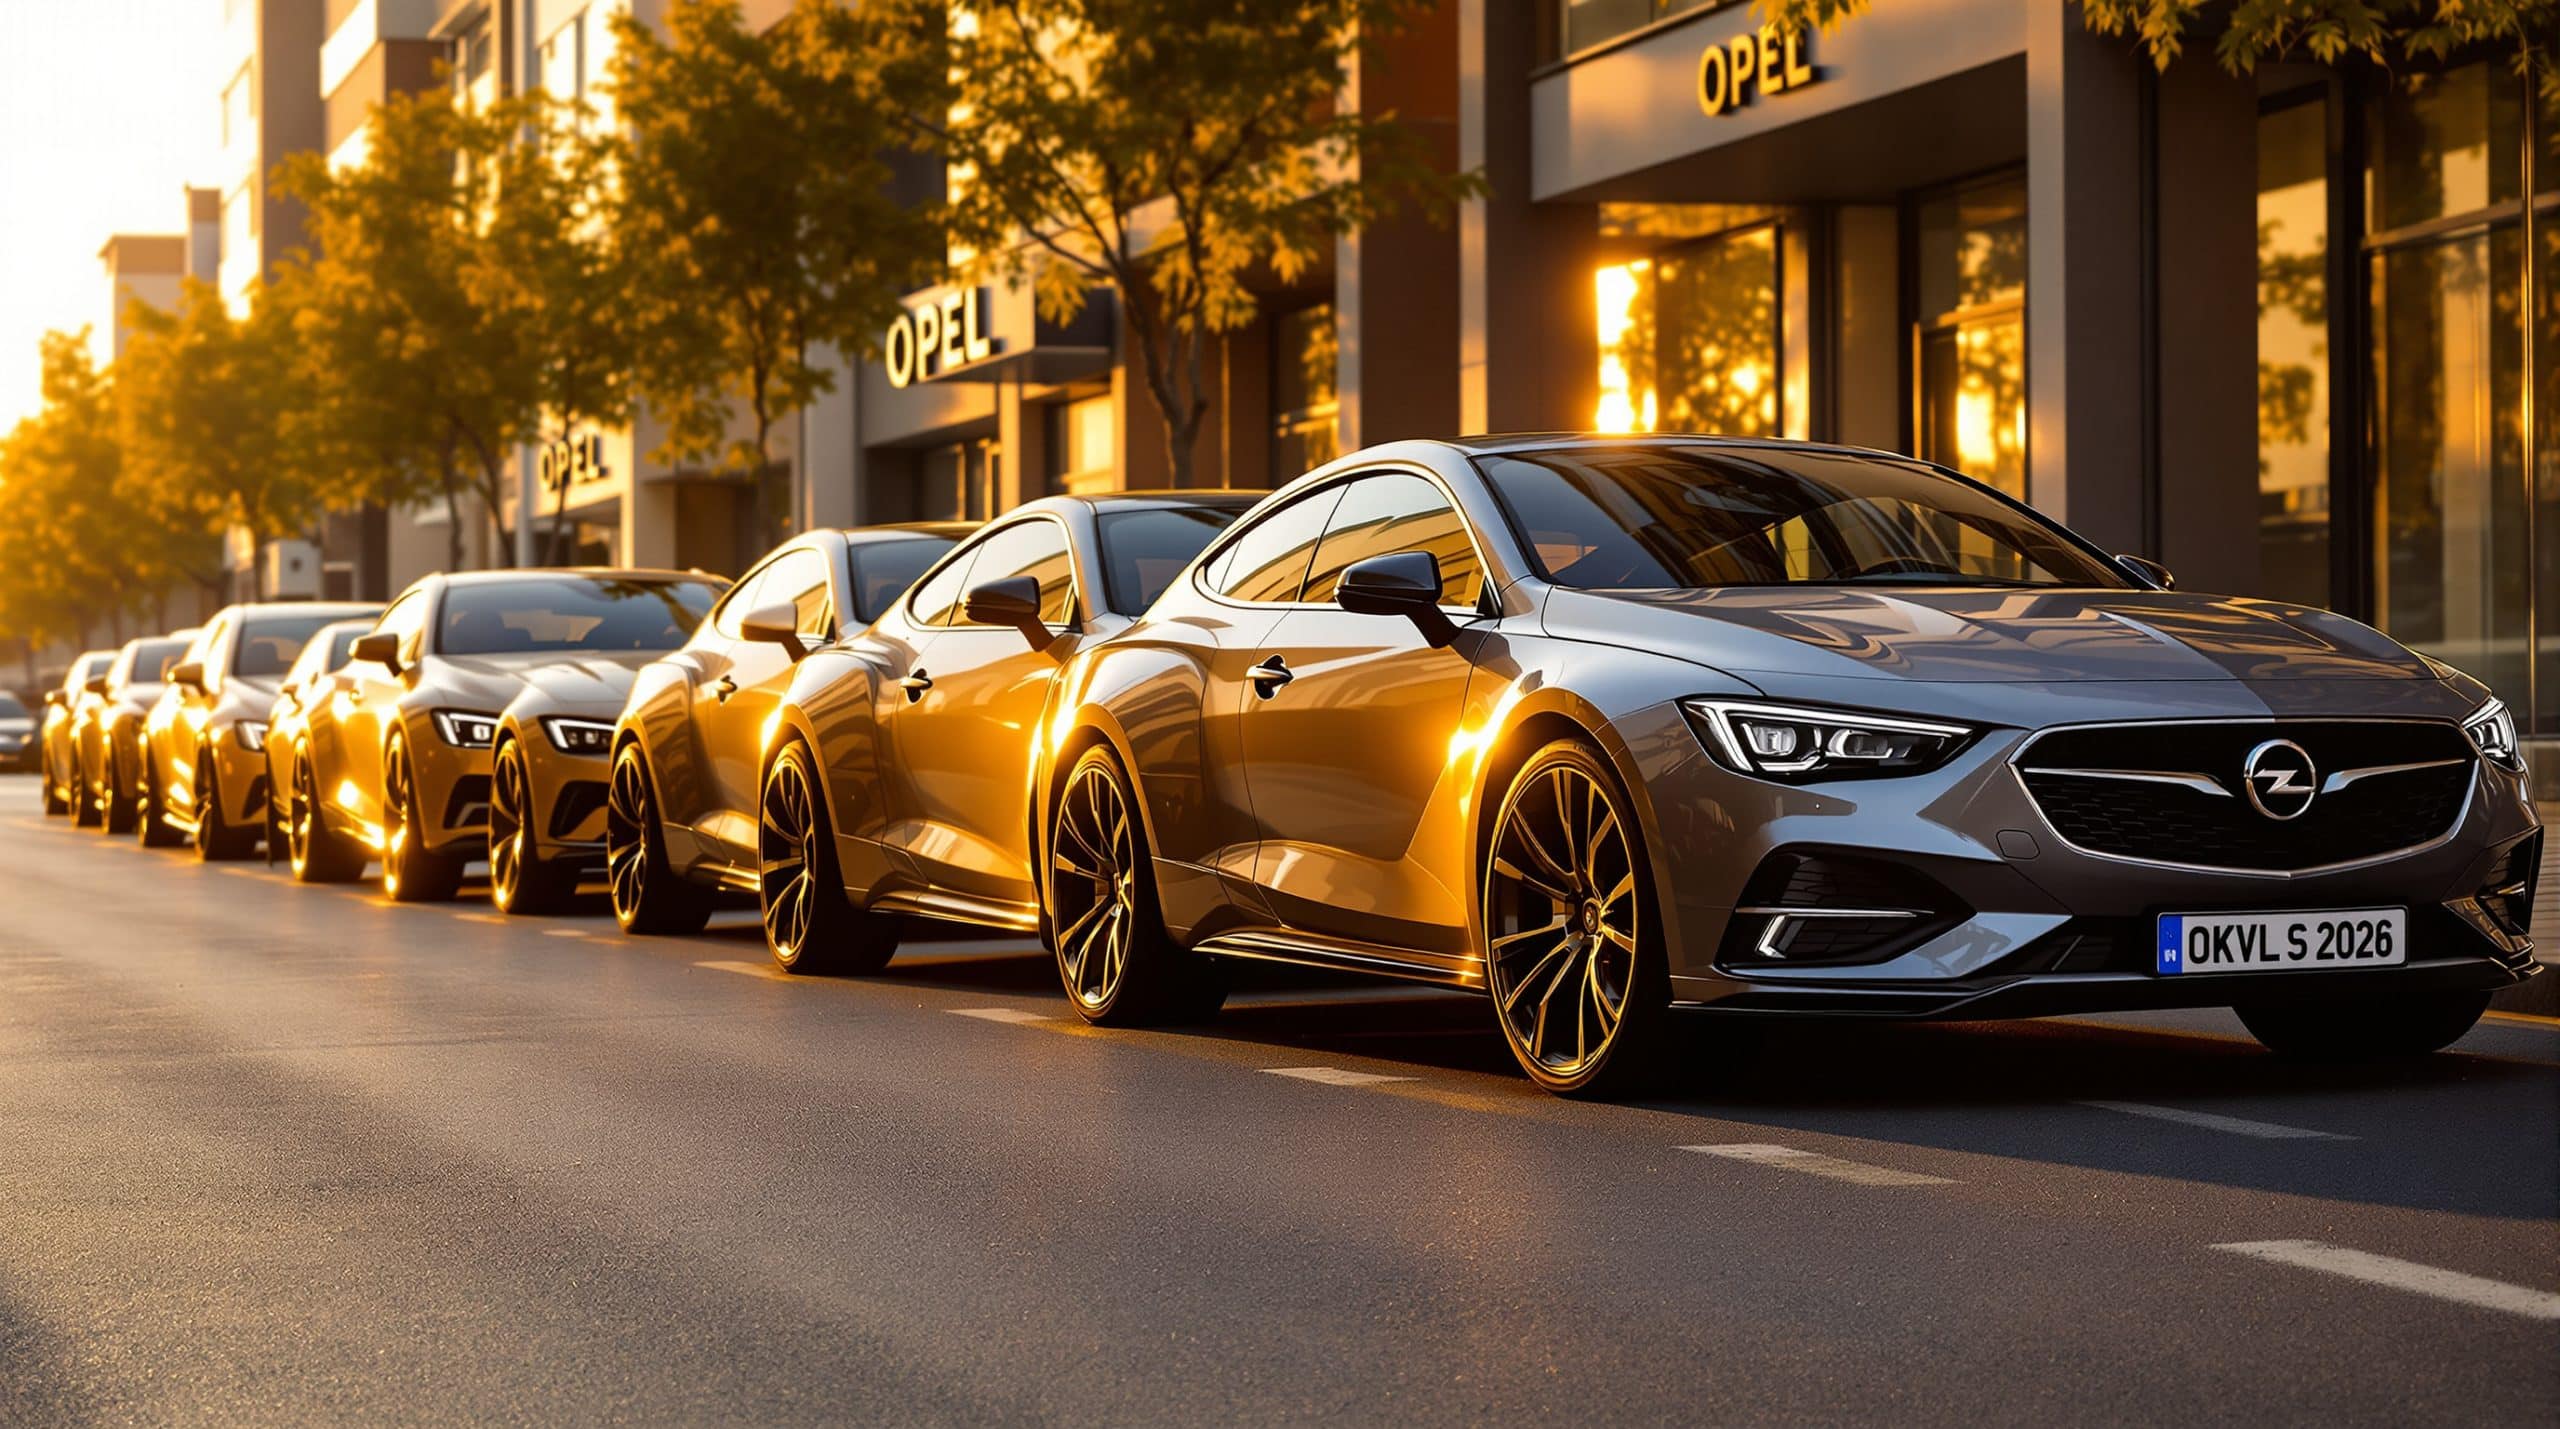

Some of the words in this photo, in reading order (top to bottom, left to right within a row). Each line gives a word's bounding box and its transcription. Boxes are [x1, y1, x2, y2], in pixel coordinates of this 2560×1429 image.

[1698, 22, 1811, 117] OPEL
[886, 286, 990, 389] OPEL
[538, 430, 600, 491] OPEL
[2188, 923, 2280, 964] OKVL
[2287, 923, 2308, 961] S
[2316, 919, 2393, 960] 2026
